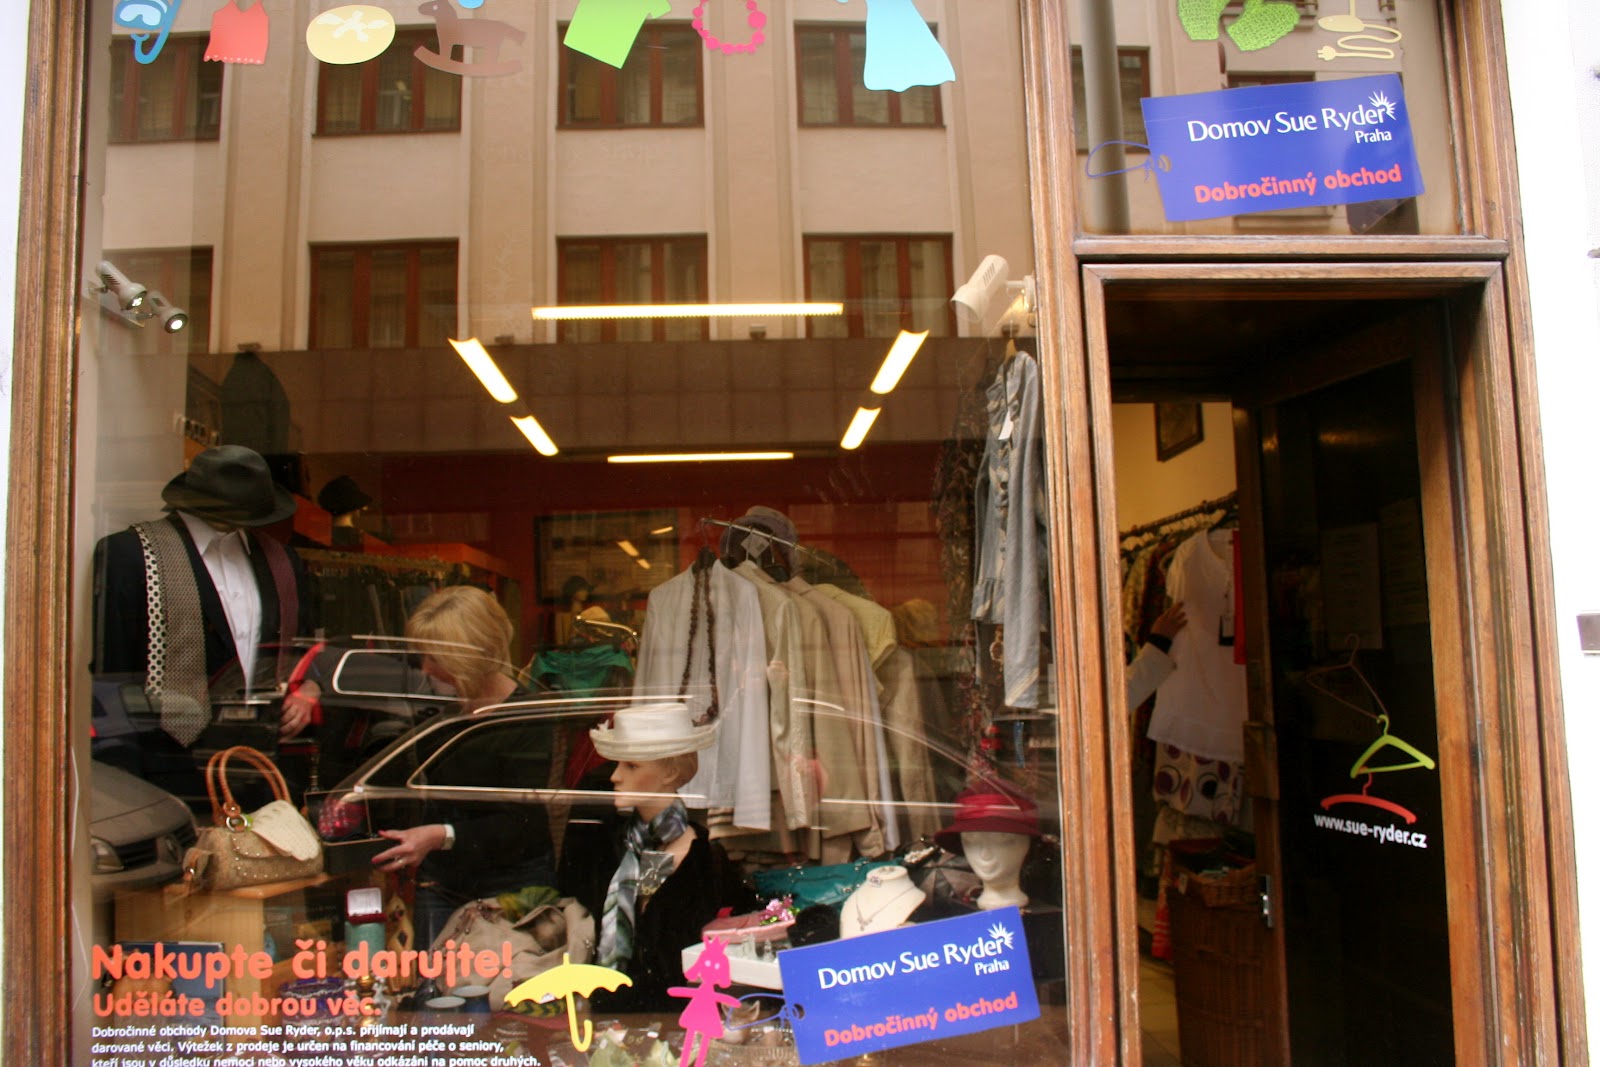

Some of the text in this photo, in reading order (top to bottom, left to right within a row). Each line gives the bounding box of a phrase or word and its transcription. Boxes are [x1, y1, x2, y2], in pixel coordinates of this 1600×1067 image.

[1187, 104, 1387, 142] Domov Sue Ryder
[1355, 129, 1392, 143] Praha
[1194, 164, 1402, 203] Dobročinný obchod
[1313, 813, 1428, 848] www.sue-ryder.cz
[92, 938, 513, 989] Nakupte či darujte!
[817, 937, 1004, 990] Domov Sue Ryder
[974, 958, 1010, 976] Praha
[93, 989, 383, 1018] Uděláte dobrou věc.
[823, 991, 1018, 1048] Dobročinný obchod
[91, 1023, 475, 1038] Dobročinné obchody Domova Sue Ryder, o.p.s. přijímají a prodávají
[91, 1041, 145, 1054] darované
[147, 1040, 174, 1053] věci.
[226, 1043, 233, 1052] z
[236, 1040, 280, 1054] prodeje
[282, 1040, 294, 1054] je
[296, 1039, 329, 1052] určen
[332, 1042, 347, 1052] na
[350, 1039, 416, 1052] financování
[418, 1039, 446, 1054] péče
[448, 1043, 456, 1052] o
[459, 1040, 504, 1054] seniory,
[159, 1055, 211, 1067] důsledku
[213, 1057, 256, 1067] nemoci
[257, 1057, 286, 1067] nebo
[288, 1056, 343, 1067] vysokého
[346, 1055, 375, 1067] věku
[377, 1055, 429, 1067] odkázáni
[431, 1058, 446, 1067] na
[449, 1057, 488, 1067] pomoc
[490, 1055, 541, 1067] druhých.
